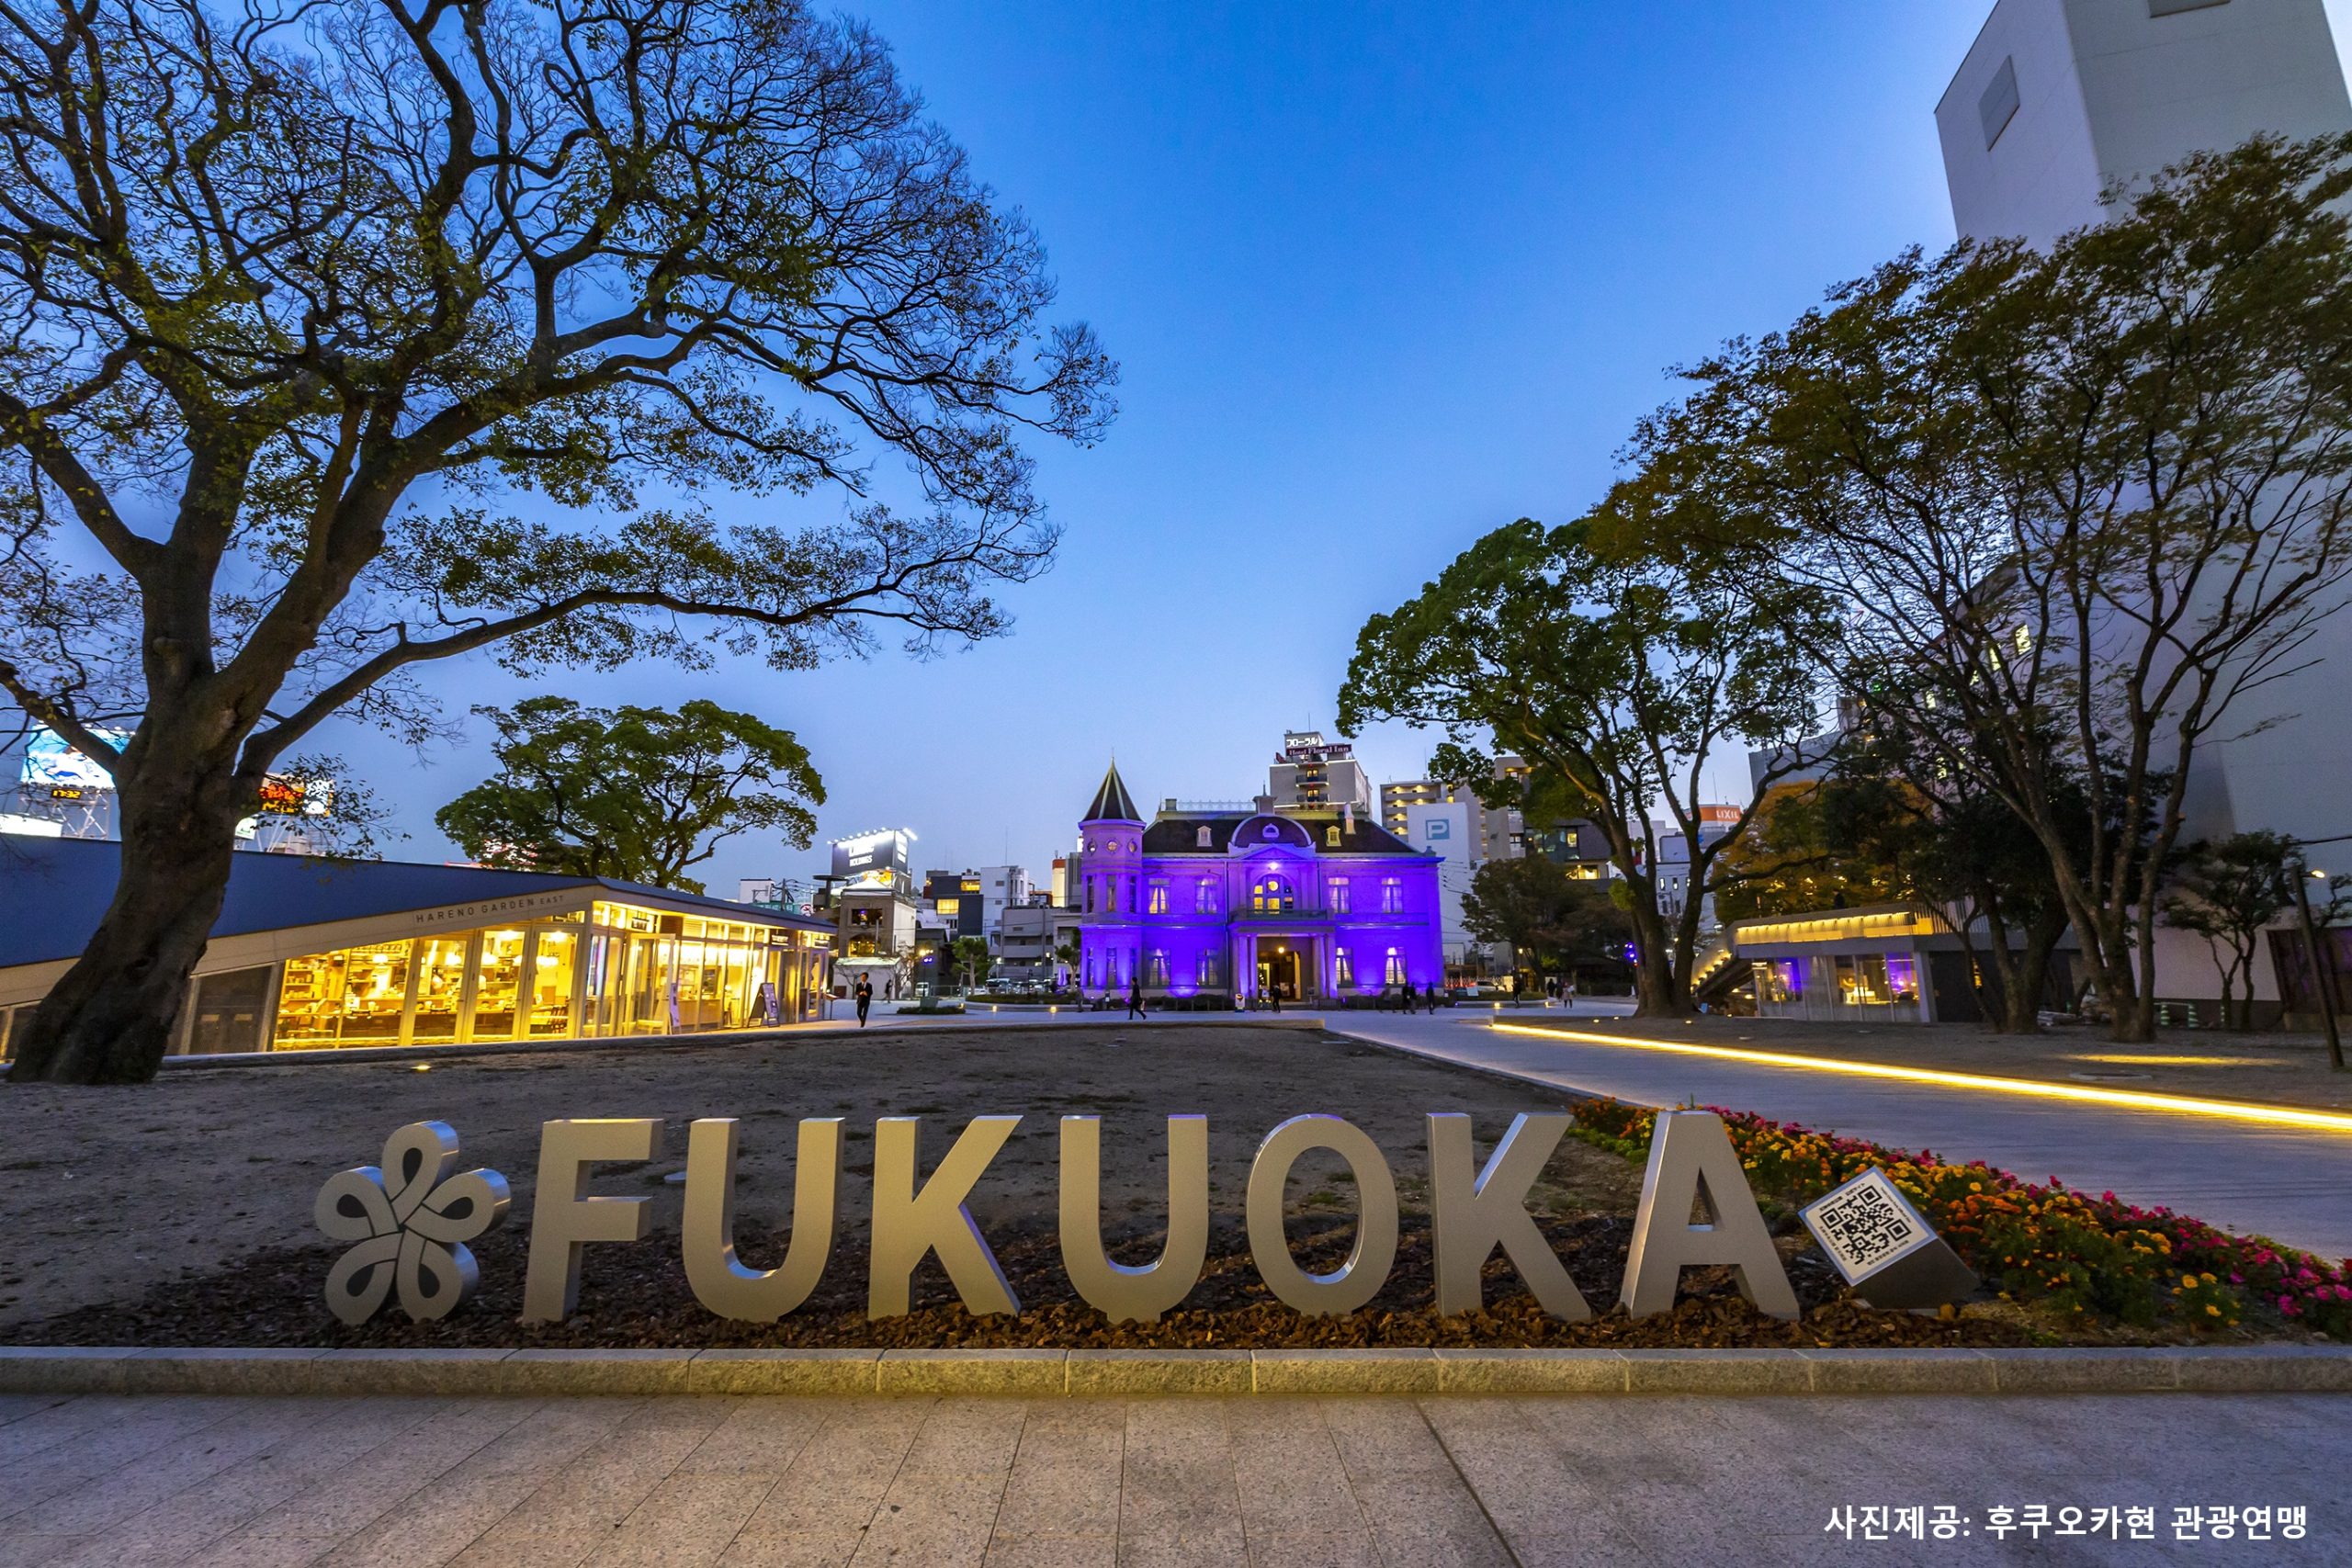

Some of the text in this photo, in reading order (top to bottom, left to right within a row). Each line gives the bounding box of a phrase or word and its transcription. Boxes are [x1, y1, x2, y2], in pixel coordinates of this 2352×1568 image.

[1308, 746, 1332, 754] Floral
[1716, 809, 1739, 819] LIXIL
[1428, 821, 1448, 839] P
[415, 895, 564, 923] HARENO GARDEN EAST
[522, 1108, 1801, 1326] FUKUOKA
